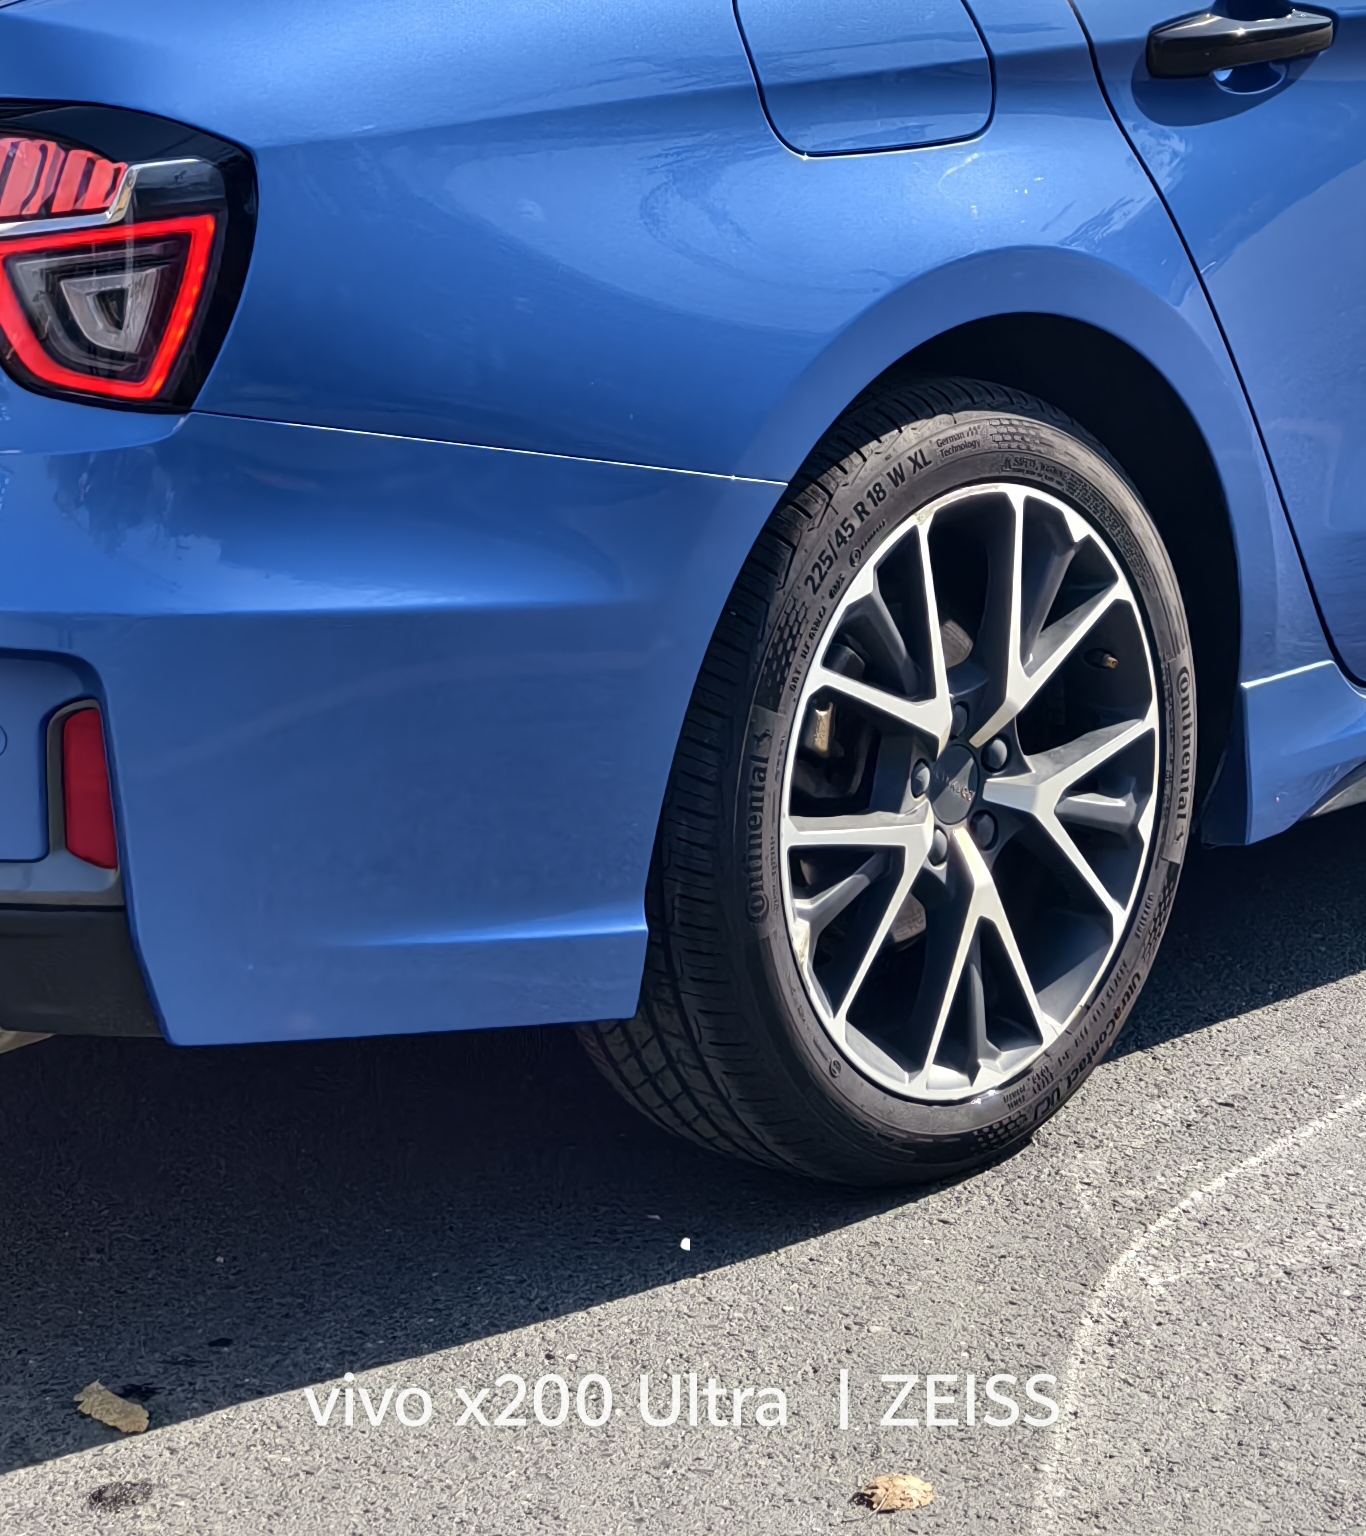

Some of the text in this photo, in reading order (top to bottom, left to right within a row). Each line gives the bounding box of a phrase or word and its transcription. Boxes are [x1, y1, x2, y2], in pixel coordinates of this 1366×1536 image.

[936, 431, 965, 449] German
[939, 439, 982, 460] Technology
[804, 517, 856, 596] 225/45
[853, 501, 870, 523] R
[866, 482, 887, 508] 18
[886, 465, 907, 489] W
[908, 448, 933, 475] XL
[1176, 666, 1193, 820] Continental
[746, 754, 770, 925] Continental
[1065, 971, 1141, 1089] UltraContact
